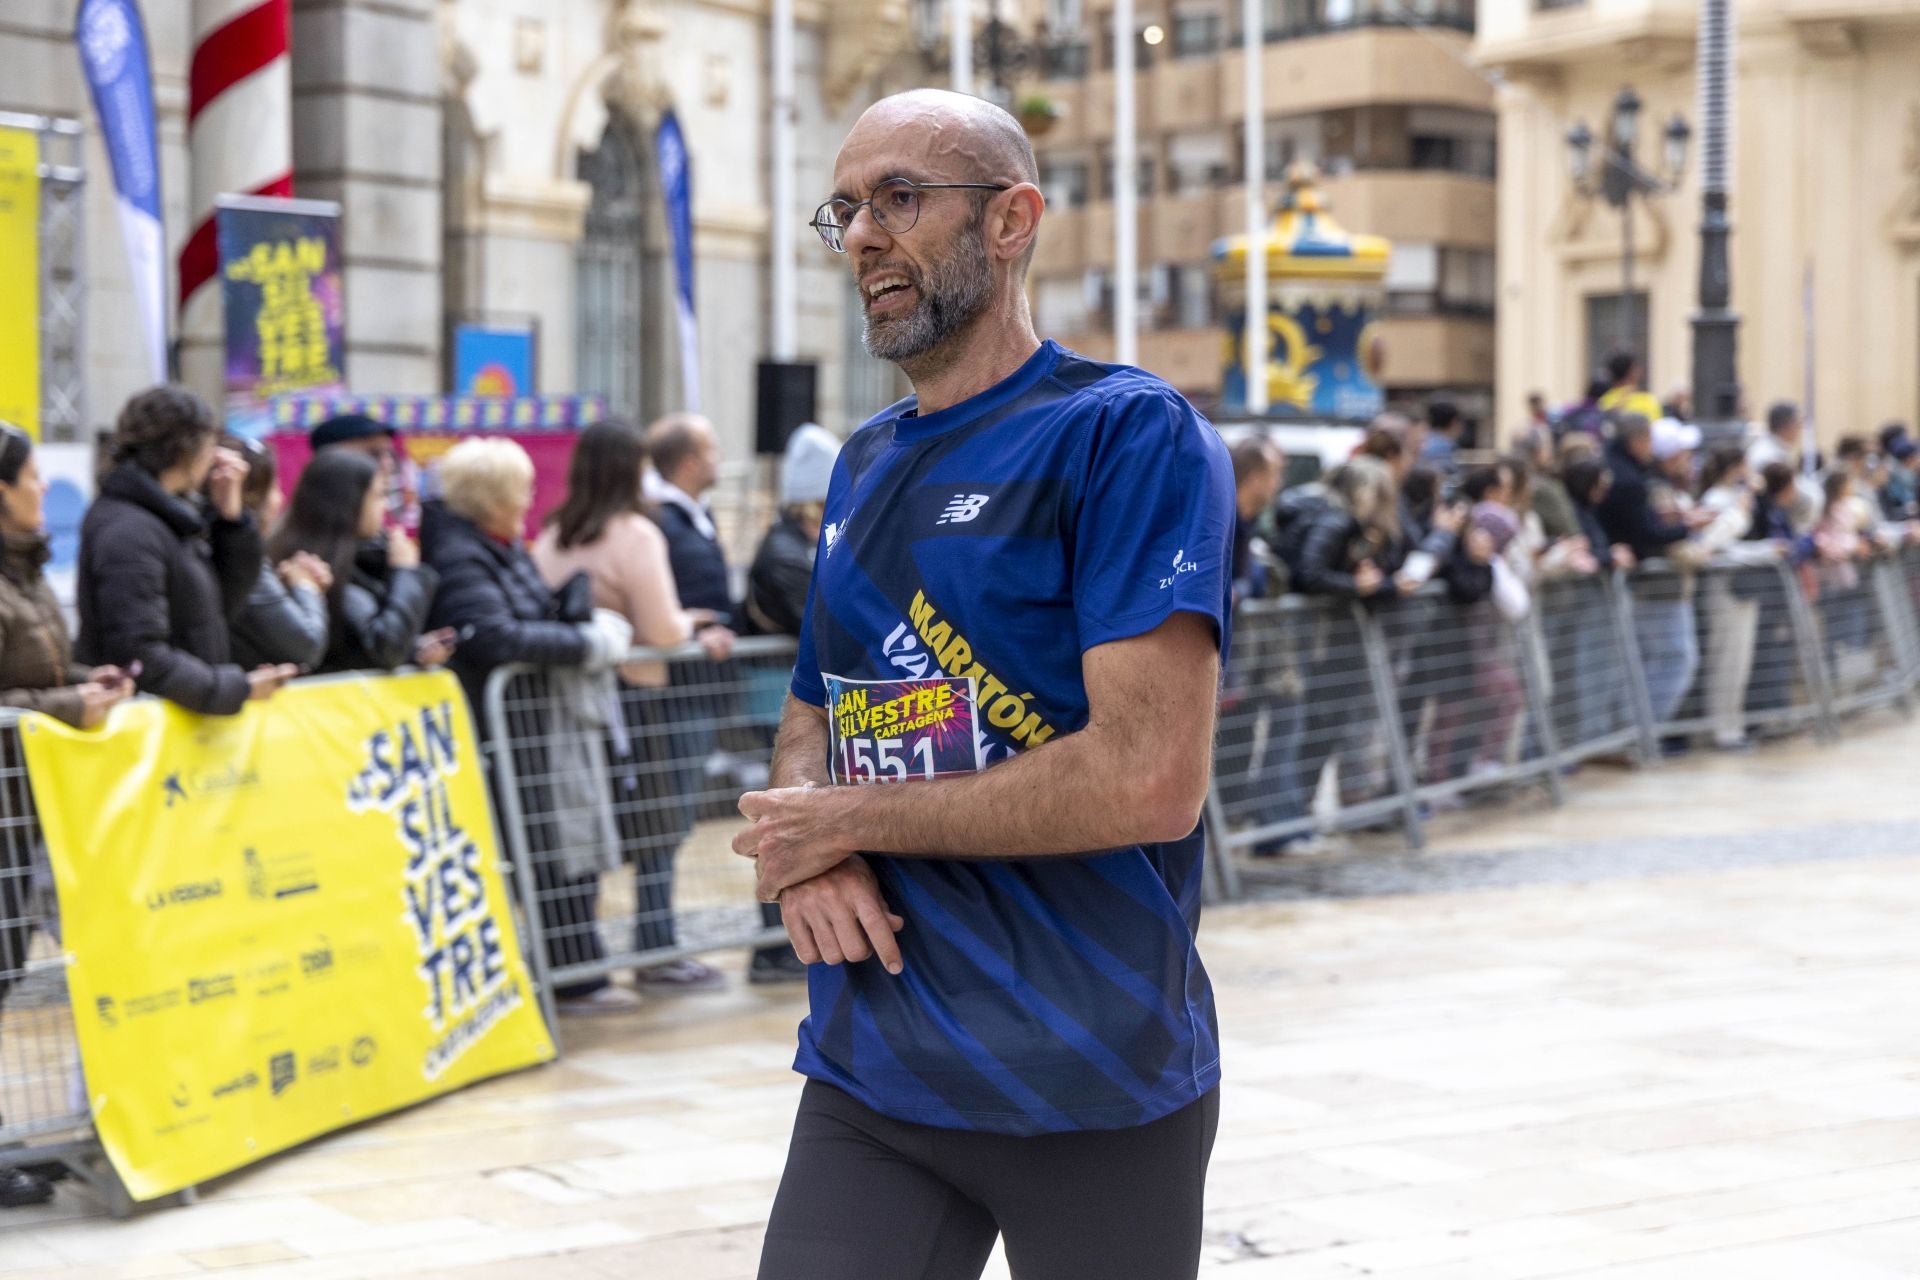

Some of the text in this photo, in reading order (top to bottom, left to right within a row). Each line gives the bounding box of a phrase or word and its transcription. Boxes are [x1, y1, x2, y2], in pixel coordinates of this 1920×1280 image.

[1160, 561, 1197, 589] ZUICH
[839, 688, 867, 717] SAN
[909, 588, 1056, 749] MARATÓN
[840, 683, 955, 739] SILVESTRE
[874, 707, 955, 740] CARTAGENA
[367, 701, 455, 801] SAN
[839, 736, 935, 785] 1551
[402, 781, 463, 870] SIL
[406, 842, 484, 941] VES
[422, 917, 505, 1020] TRE
